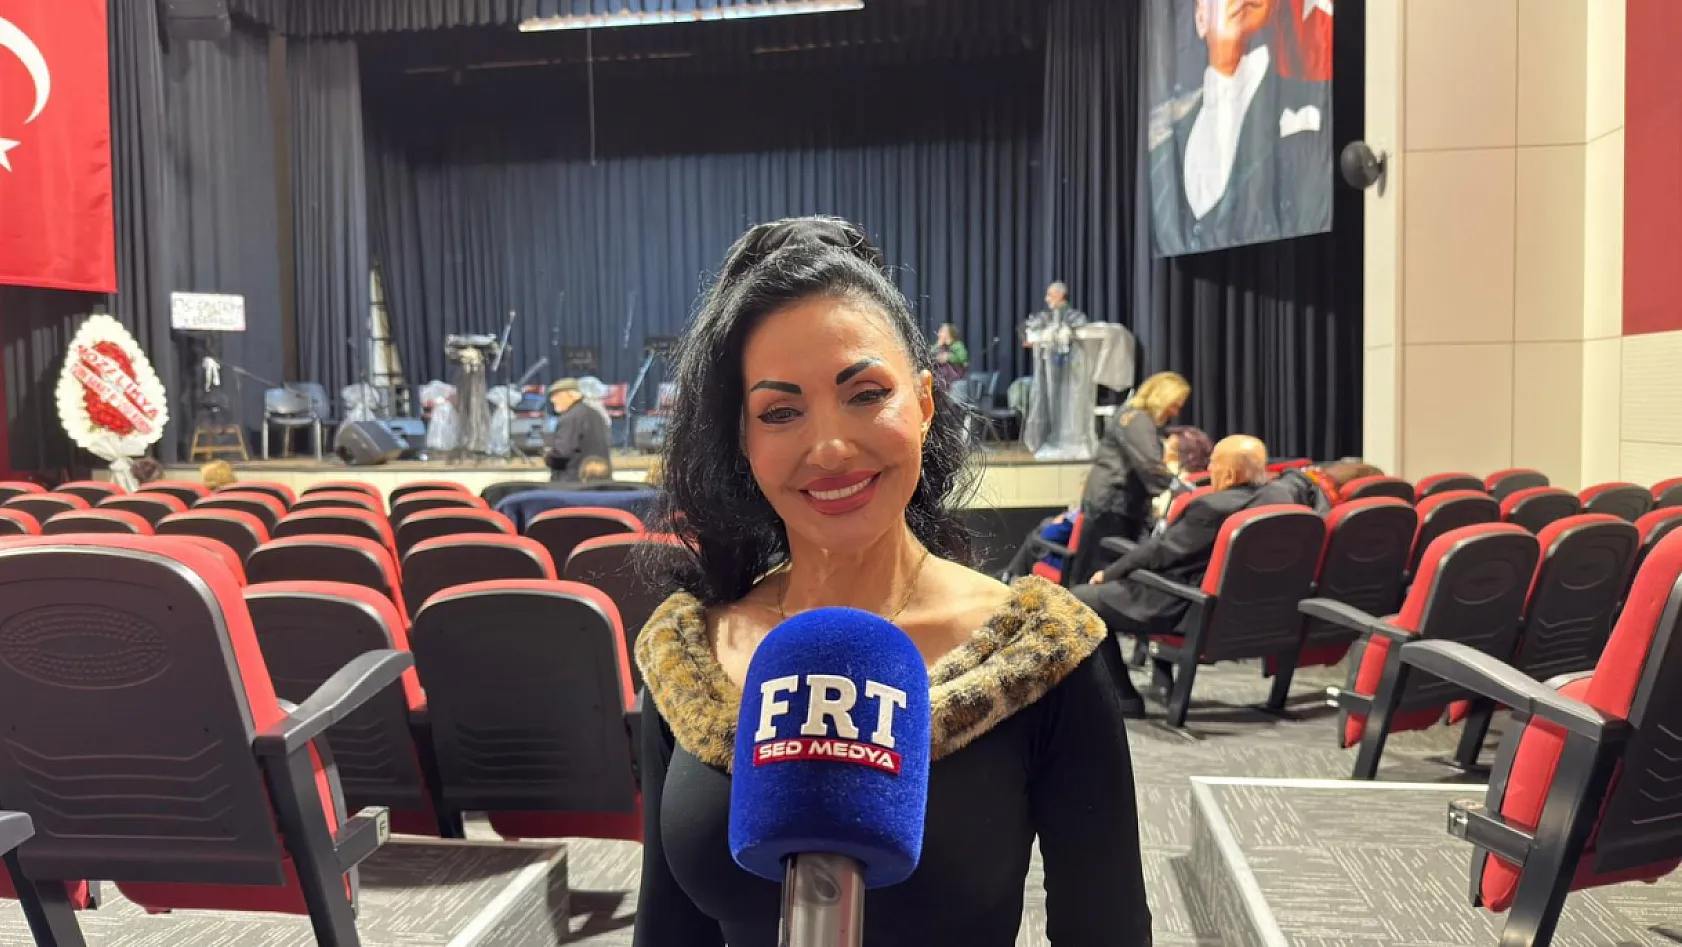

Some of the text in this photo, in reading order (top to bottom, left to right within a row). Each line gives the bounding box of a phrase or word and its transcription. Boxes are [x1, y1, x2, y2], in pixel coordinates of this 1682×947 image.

[754, 674, 907, 748] FRT
[759, 741, 895, 769] SED MEDYA
